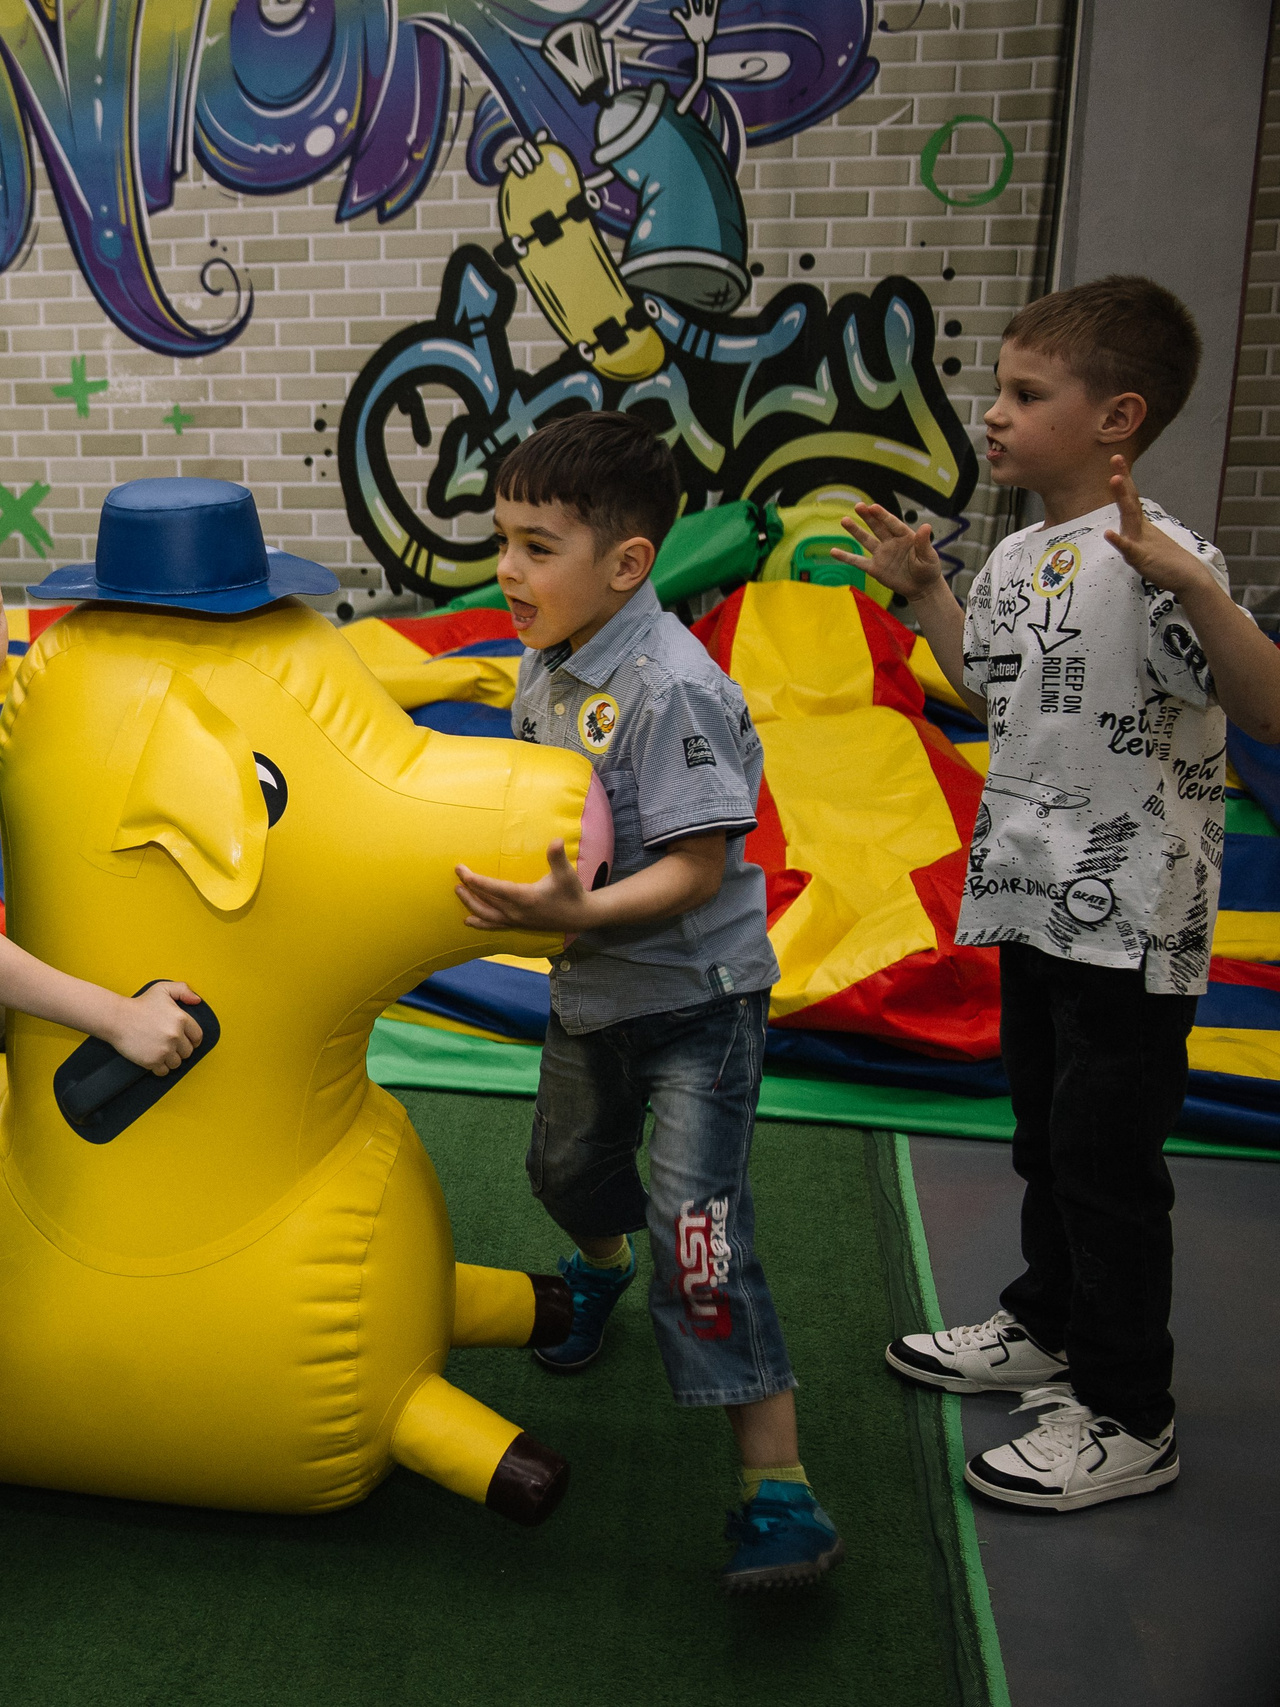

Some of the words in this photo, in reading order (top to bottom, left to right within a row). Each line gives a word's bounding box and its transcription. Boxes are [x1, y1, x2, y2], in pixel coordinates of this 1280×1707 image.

[1040, 656, 1062, 714] ROLLING
[1065, 656, 1086, 692] KEEP
[1062, 695, 1083, 714] ON
[1163, 705, 1183, 739] KEEP
[1157, 742, 1172, 762] ON
[1172, 753, 1220, 781] new
[968, 875, 1060, 900] BOARDING
[1071, 889, 1109, 906] SKATE
[1114, 919, 1134, 938] BEST
[1122, 937, 1139, 952] THE
